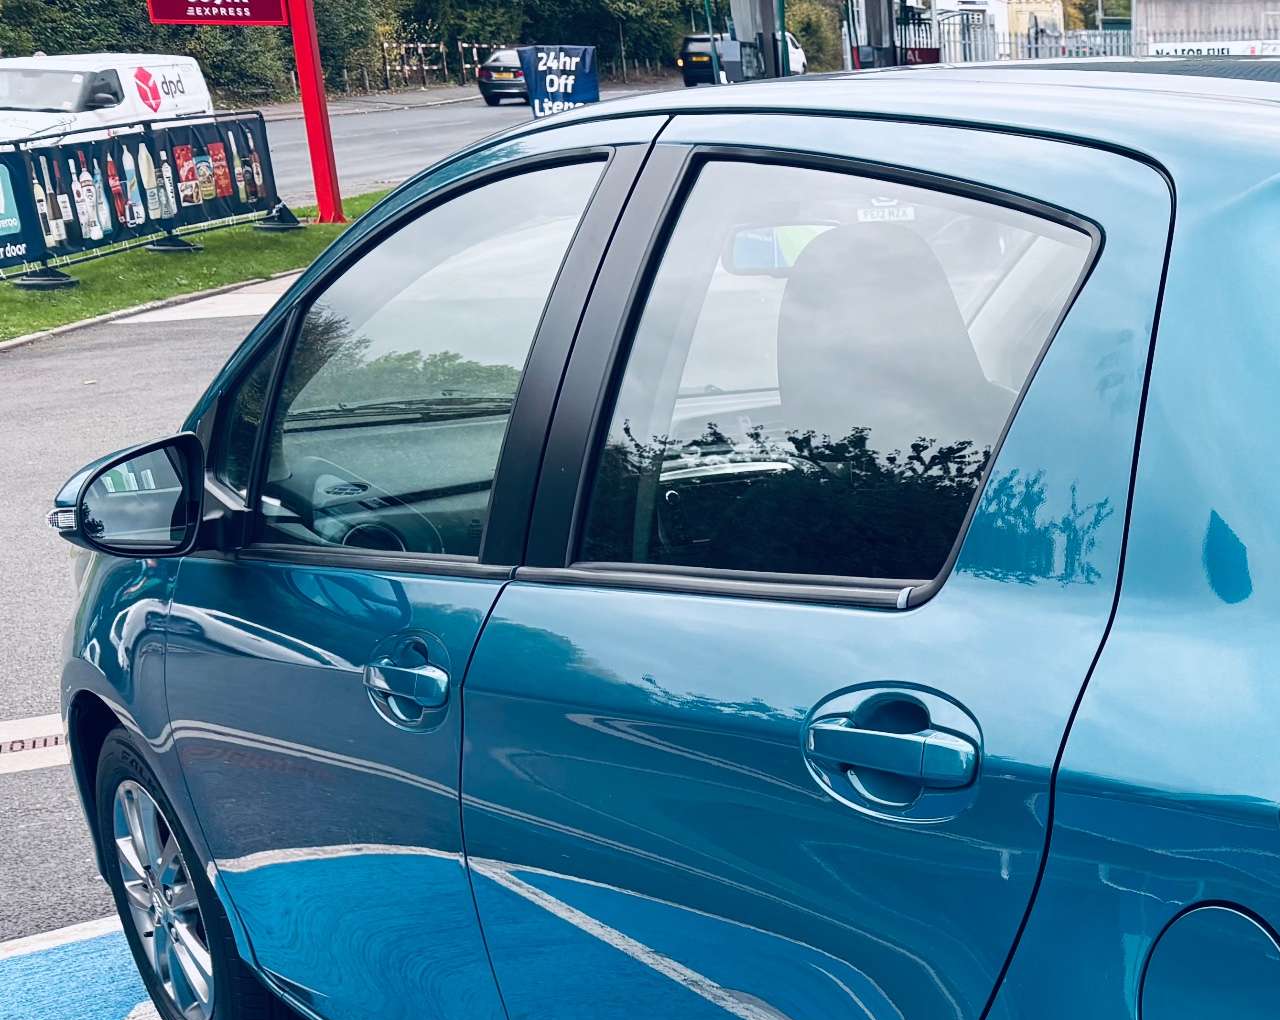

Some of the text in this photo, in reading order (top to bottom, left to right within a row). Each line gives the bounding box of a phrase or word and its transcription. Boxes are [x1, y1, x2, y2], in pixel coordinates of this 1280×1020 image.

[195, 7, 251, 16] EXPRESS
[537, 51, 581, 72] 24hr
[161, 72, 185, 98] dpd
[545, 74, 576, 94] Off
[5, 243, 27, 257] door
